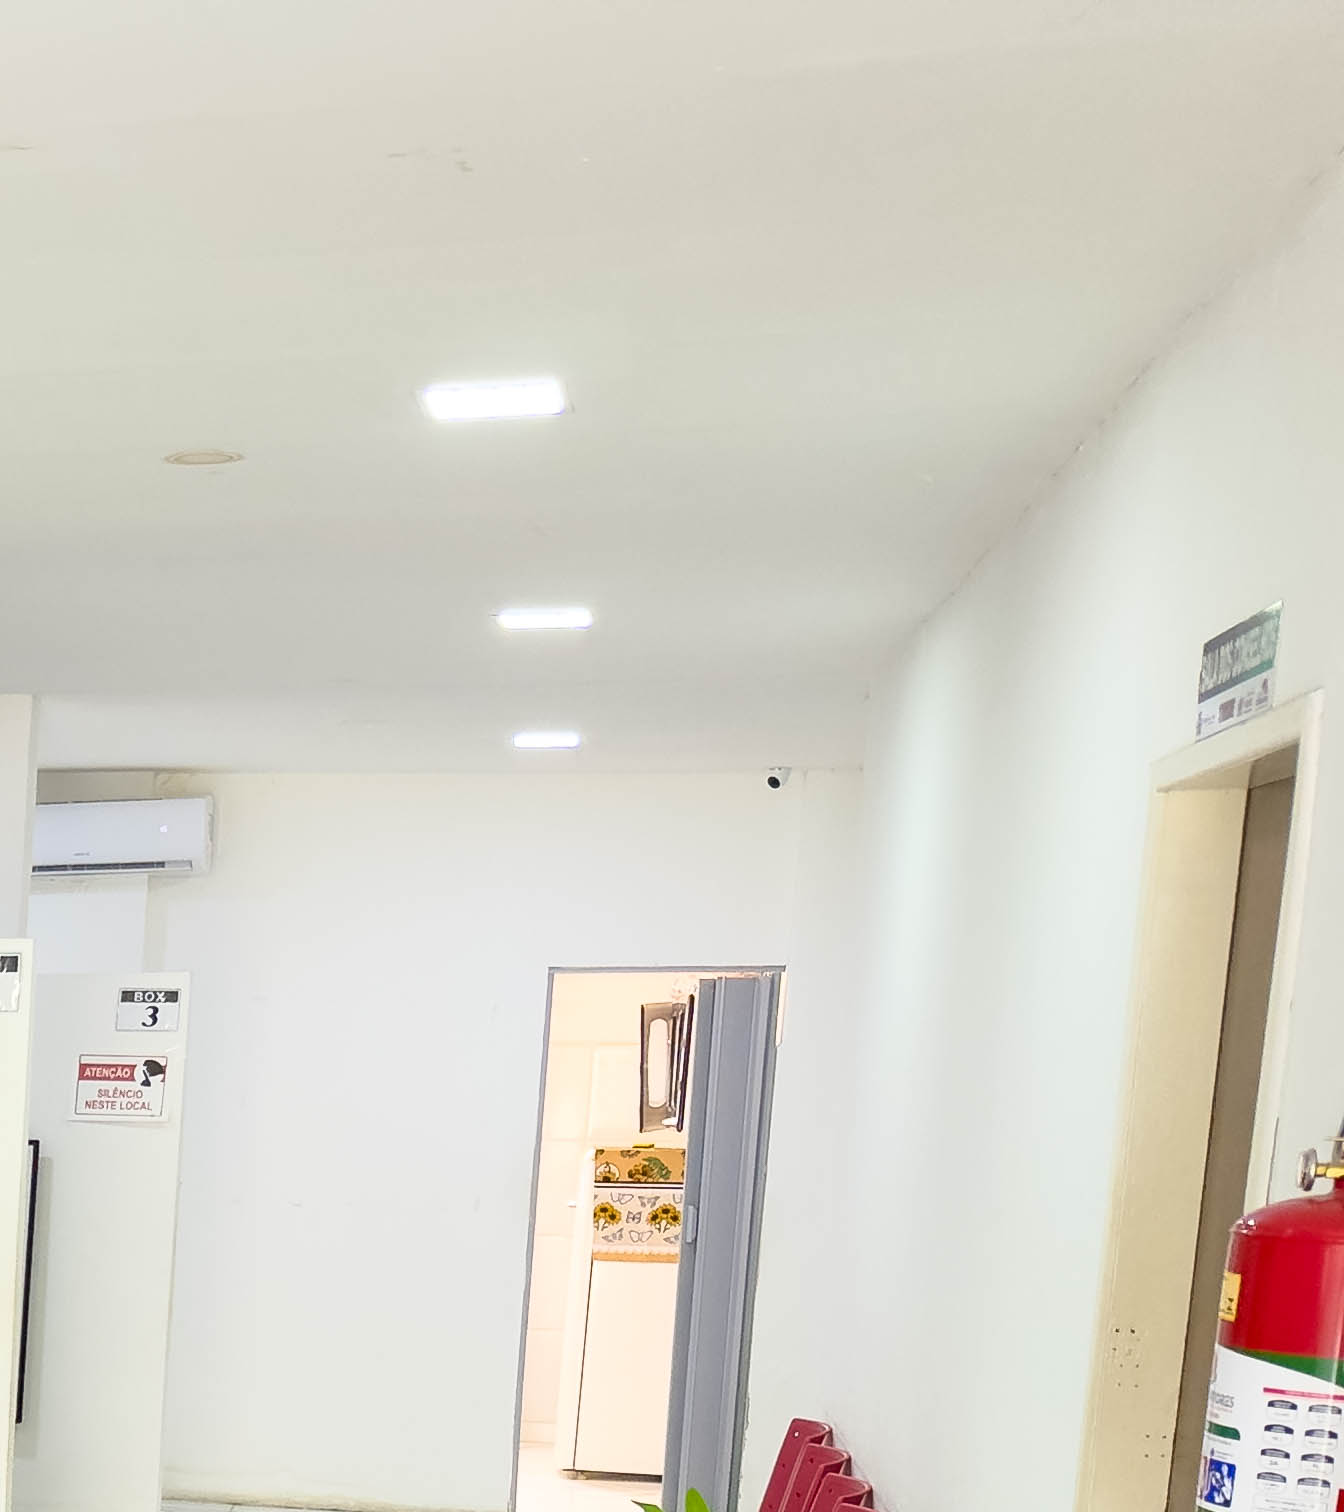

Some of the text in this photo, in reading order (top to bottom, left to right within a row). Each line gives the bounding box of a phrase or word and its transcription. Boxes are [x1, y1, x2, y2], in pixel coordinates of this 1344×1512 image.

[133, 991, 166, 1003] BOX
[141, 1005, 160, 1027] 3
[83, 1066, 131, 1080] ATENÇÃO
[97, 1086, 143, 1099] SILÊNCIO
[84, 1100, 153, 1112] NESTE LOCAL
